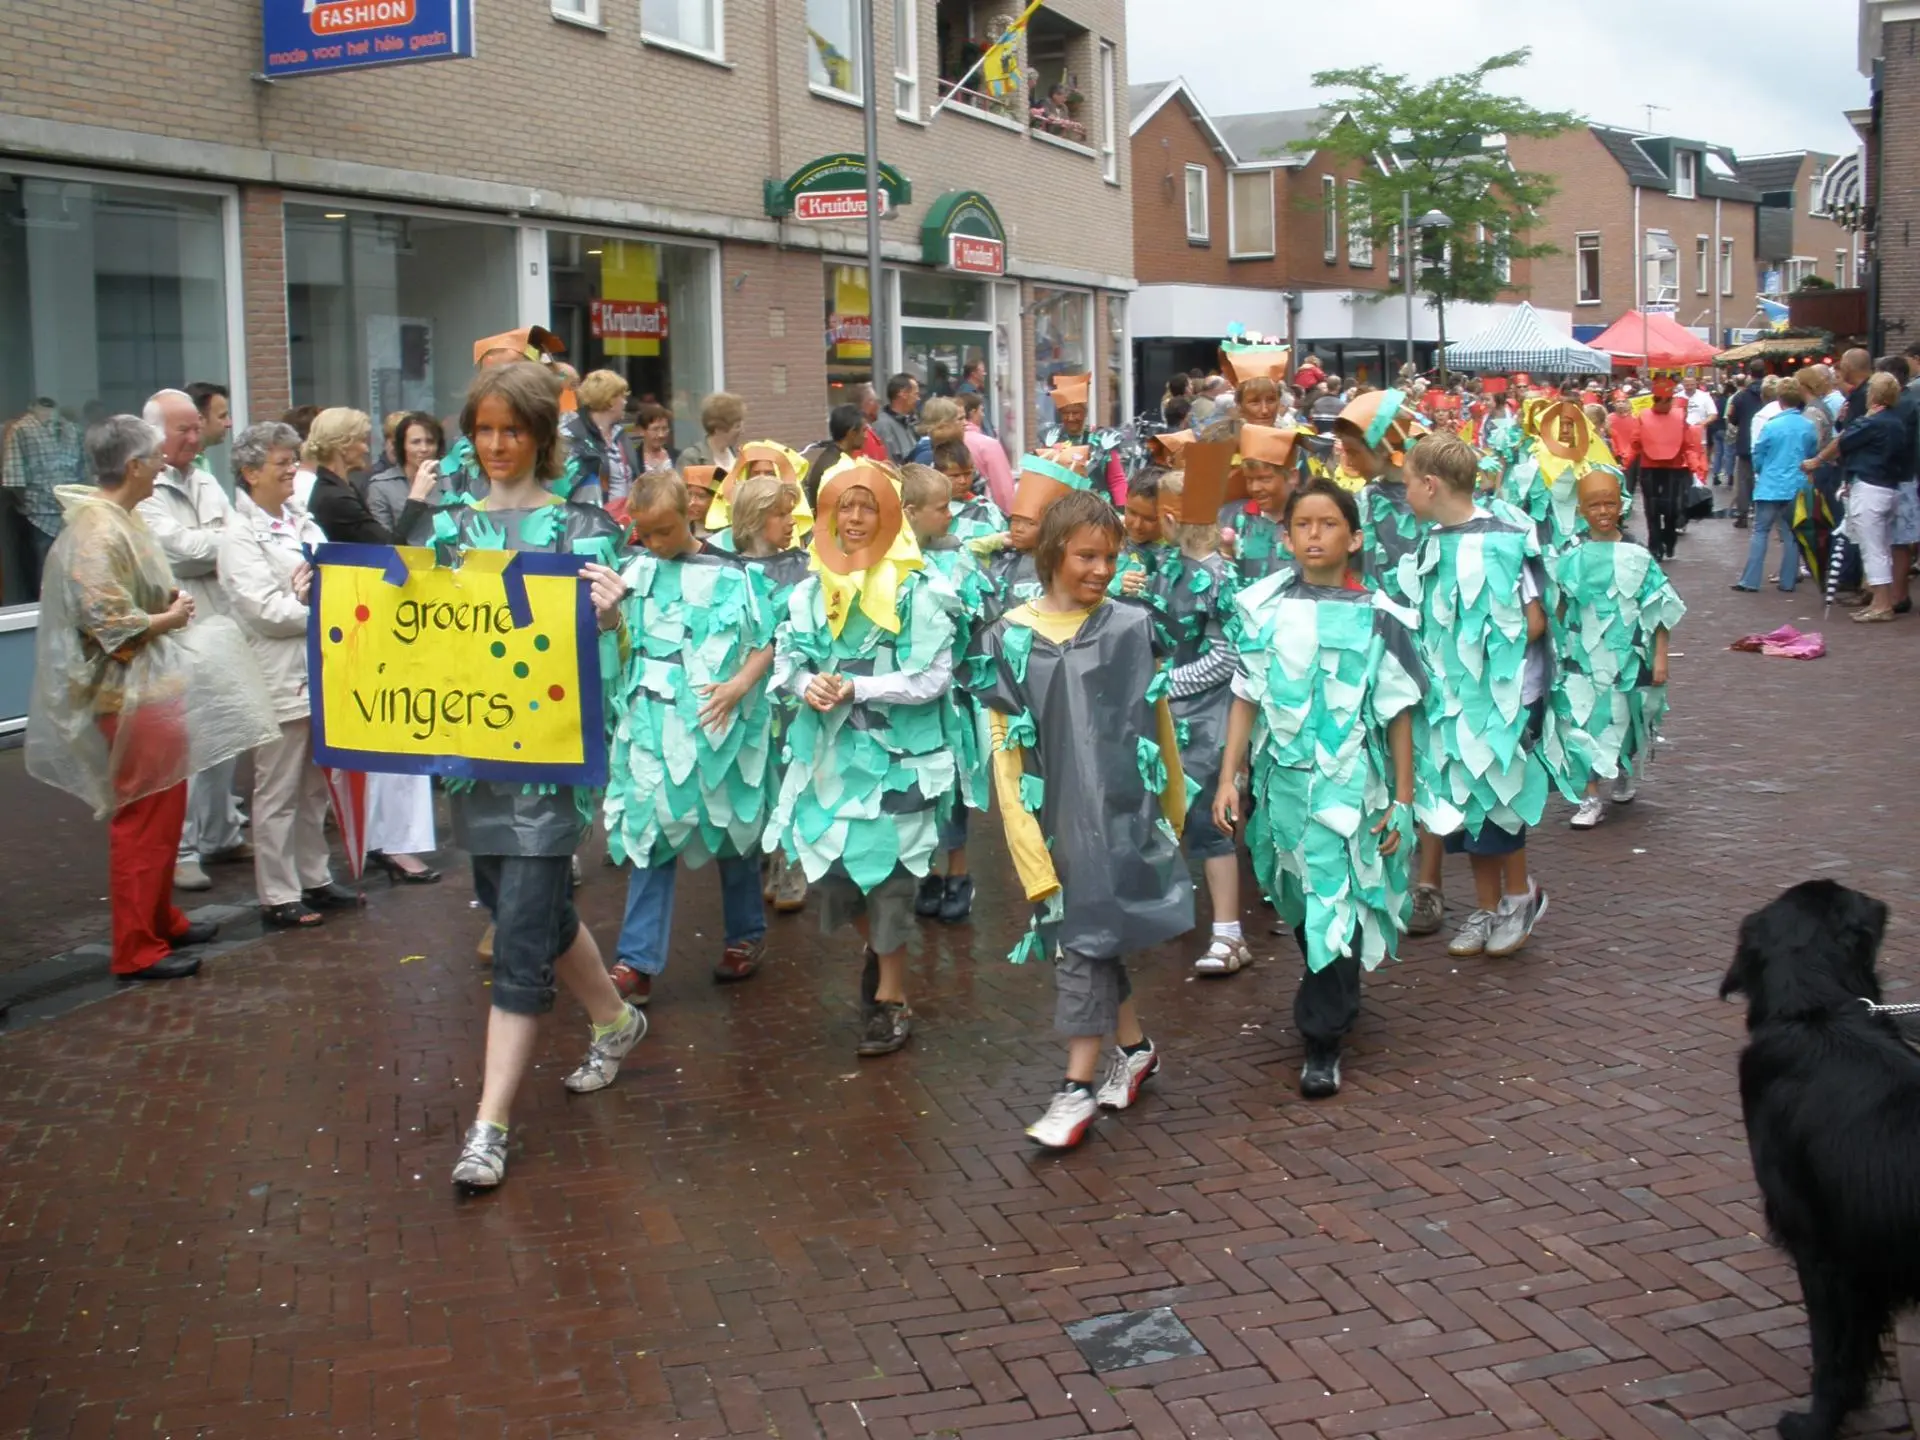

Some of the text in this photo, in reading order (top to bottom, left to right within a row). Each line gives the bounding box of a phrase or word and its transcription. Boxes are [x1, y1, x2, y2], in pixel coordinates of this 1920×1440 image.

[320, 1, 406, 28] FASHION
[269, 48, 308, 66] mode
[312, 45, 342, 60] voor
[346, 39, 369, 56] het
[409, 31, 447, 51] gezin
[809, 196, 869, 214] Kruidva
[602, 304, 660, 333] Kruidvat
[392, 600, 513, 645] groene
[352, 661, 516, 741] vingers
